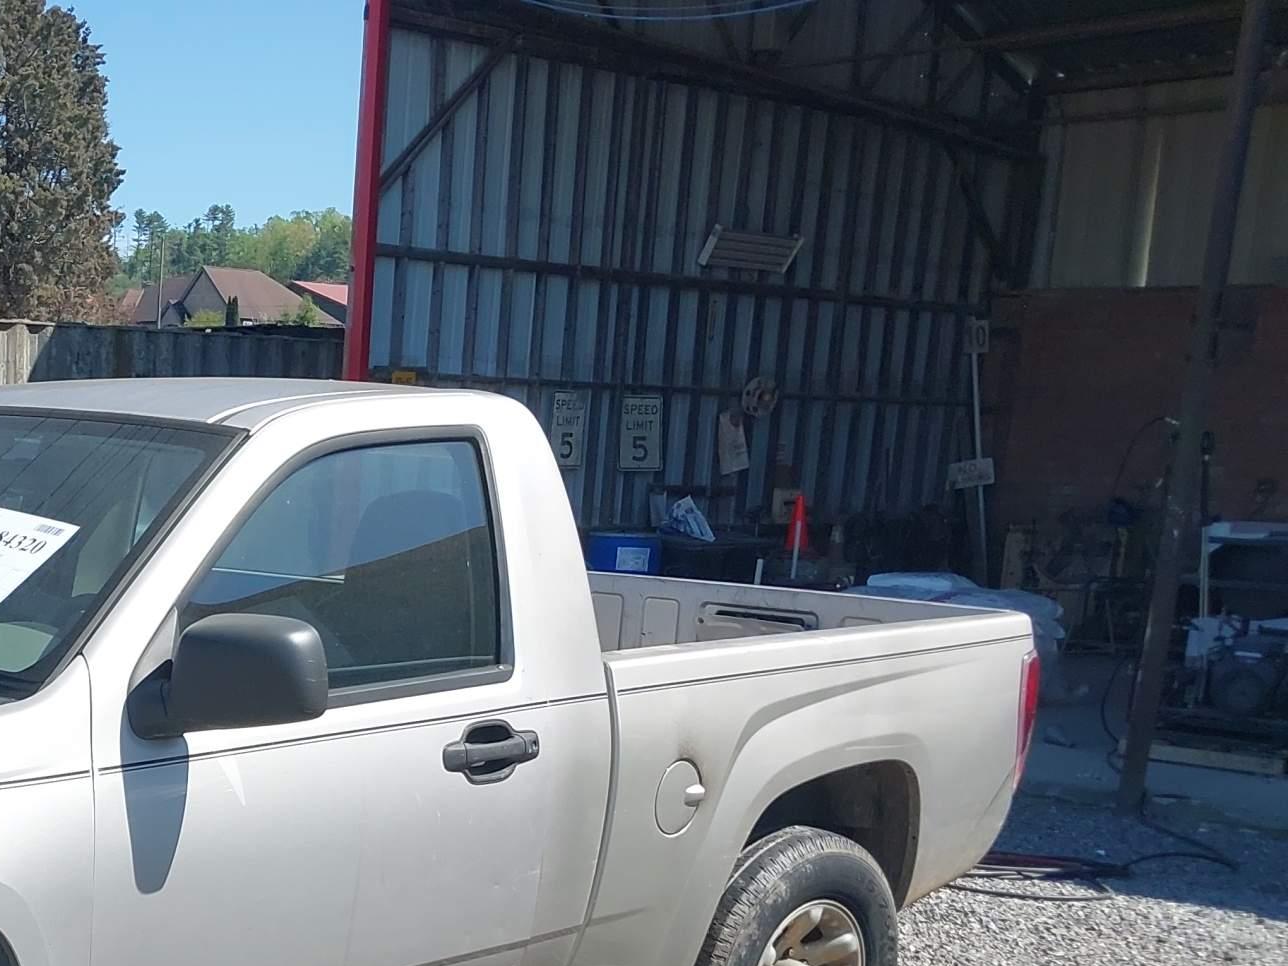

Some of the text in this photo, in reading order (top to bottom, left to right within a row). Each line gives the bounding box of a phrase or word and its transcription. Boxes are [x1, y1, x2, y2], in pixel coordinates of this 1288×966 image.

[623, 404, 658, 415] SPEED
[556, 416, 580, 426] LIMIT
[626, 420, 654, 431] LIMIT
[560, 432, 573, 459] 5
[632, 436, 648, 461] 5
